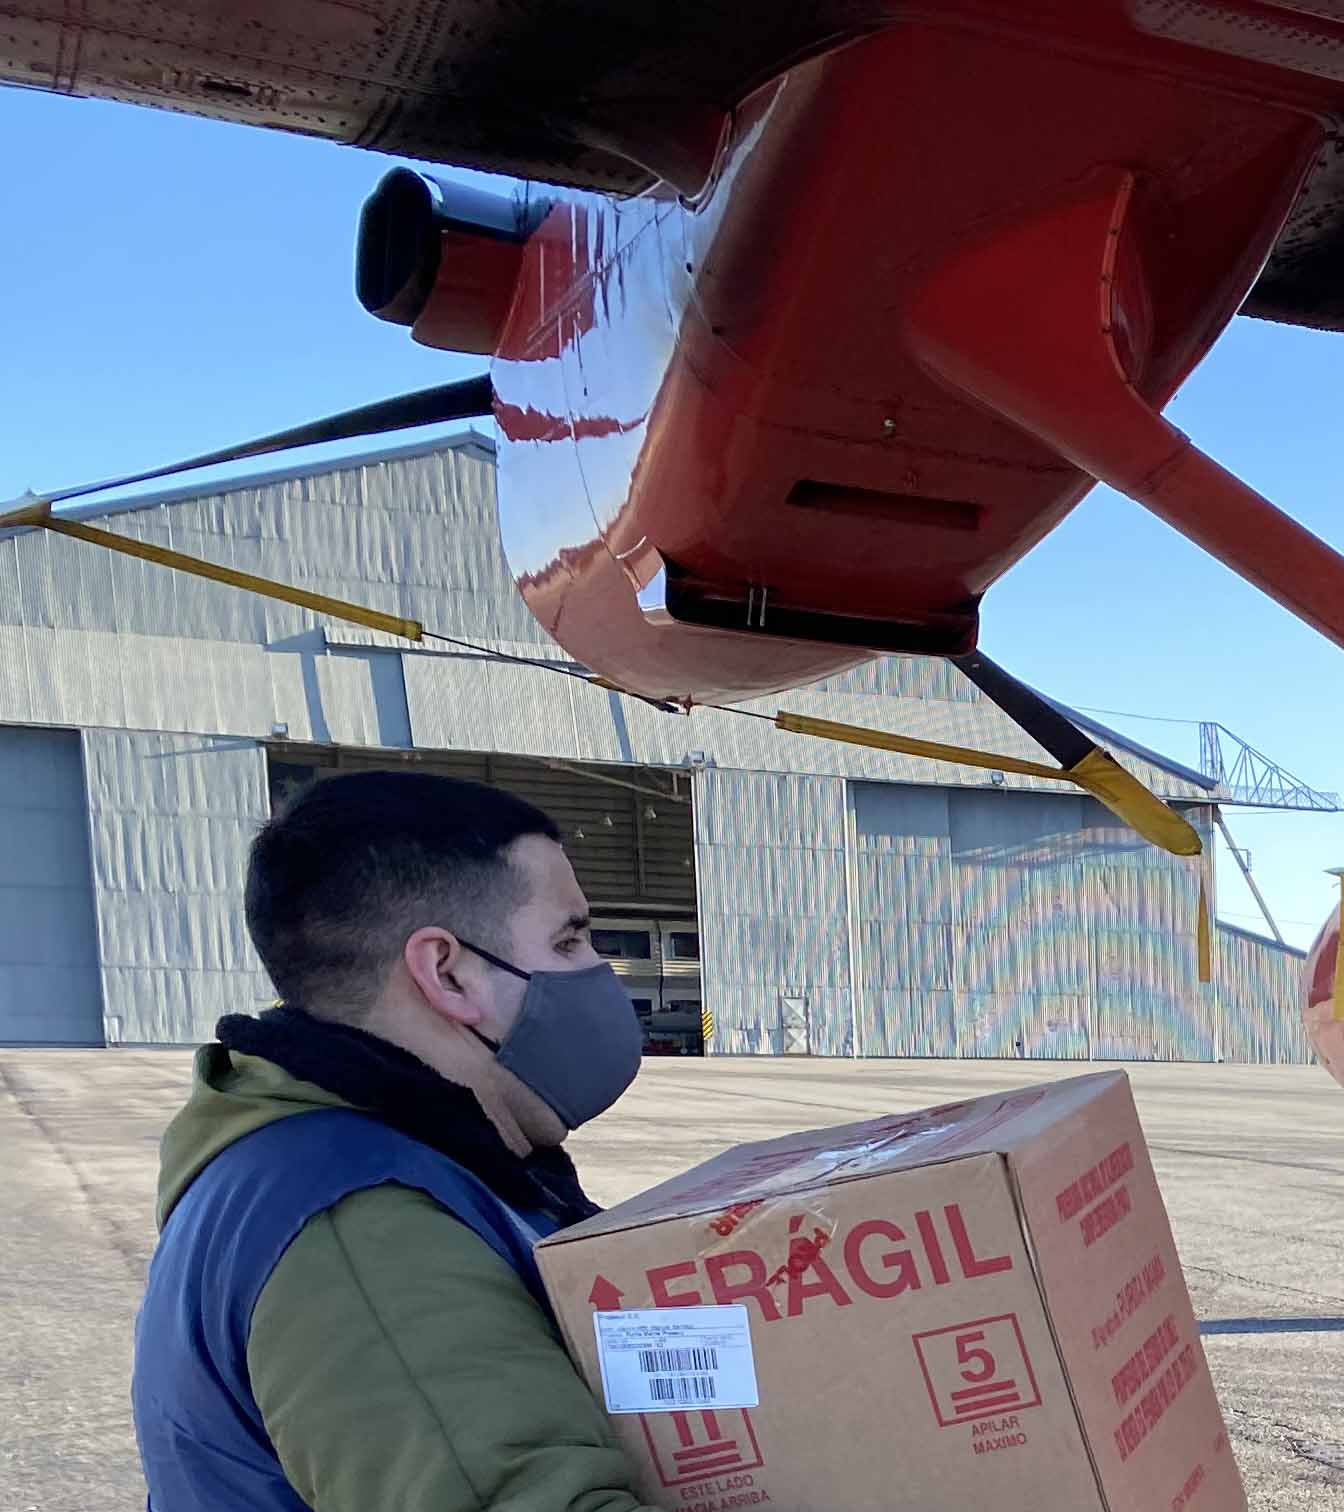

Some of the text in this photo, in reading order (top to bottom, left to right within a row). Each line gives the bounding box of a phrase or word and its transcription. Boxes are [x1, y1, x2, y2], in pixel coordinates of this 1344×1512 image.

[646, 1203, 1013, 1321] FRÁGIL
[955, 1330, 997, 1383] 5
[970, 1415, 1021, 1438] APILAR
[680, 1474, 754, 1501] ESTE LADO
[720, 1488, 772, 1511] ARRIBA
